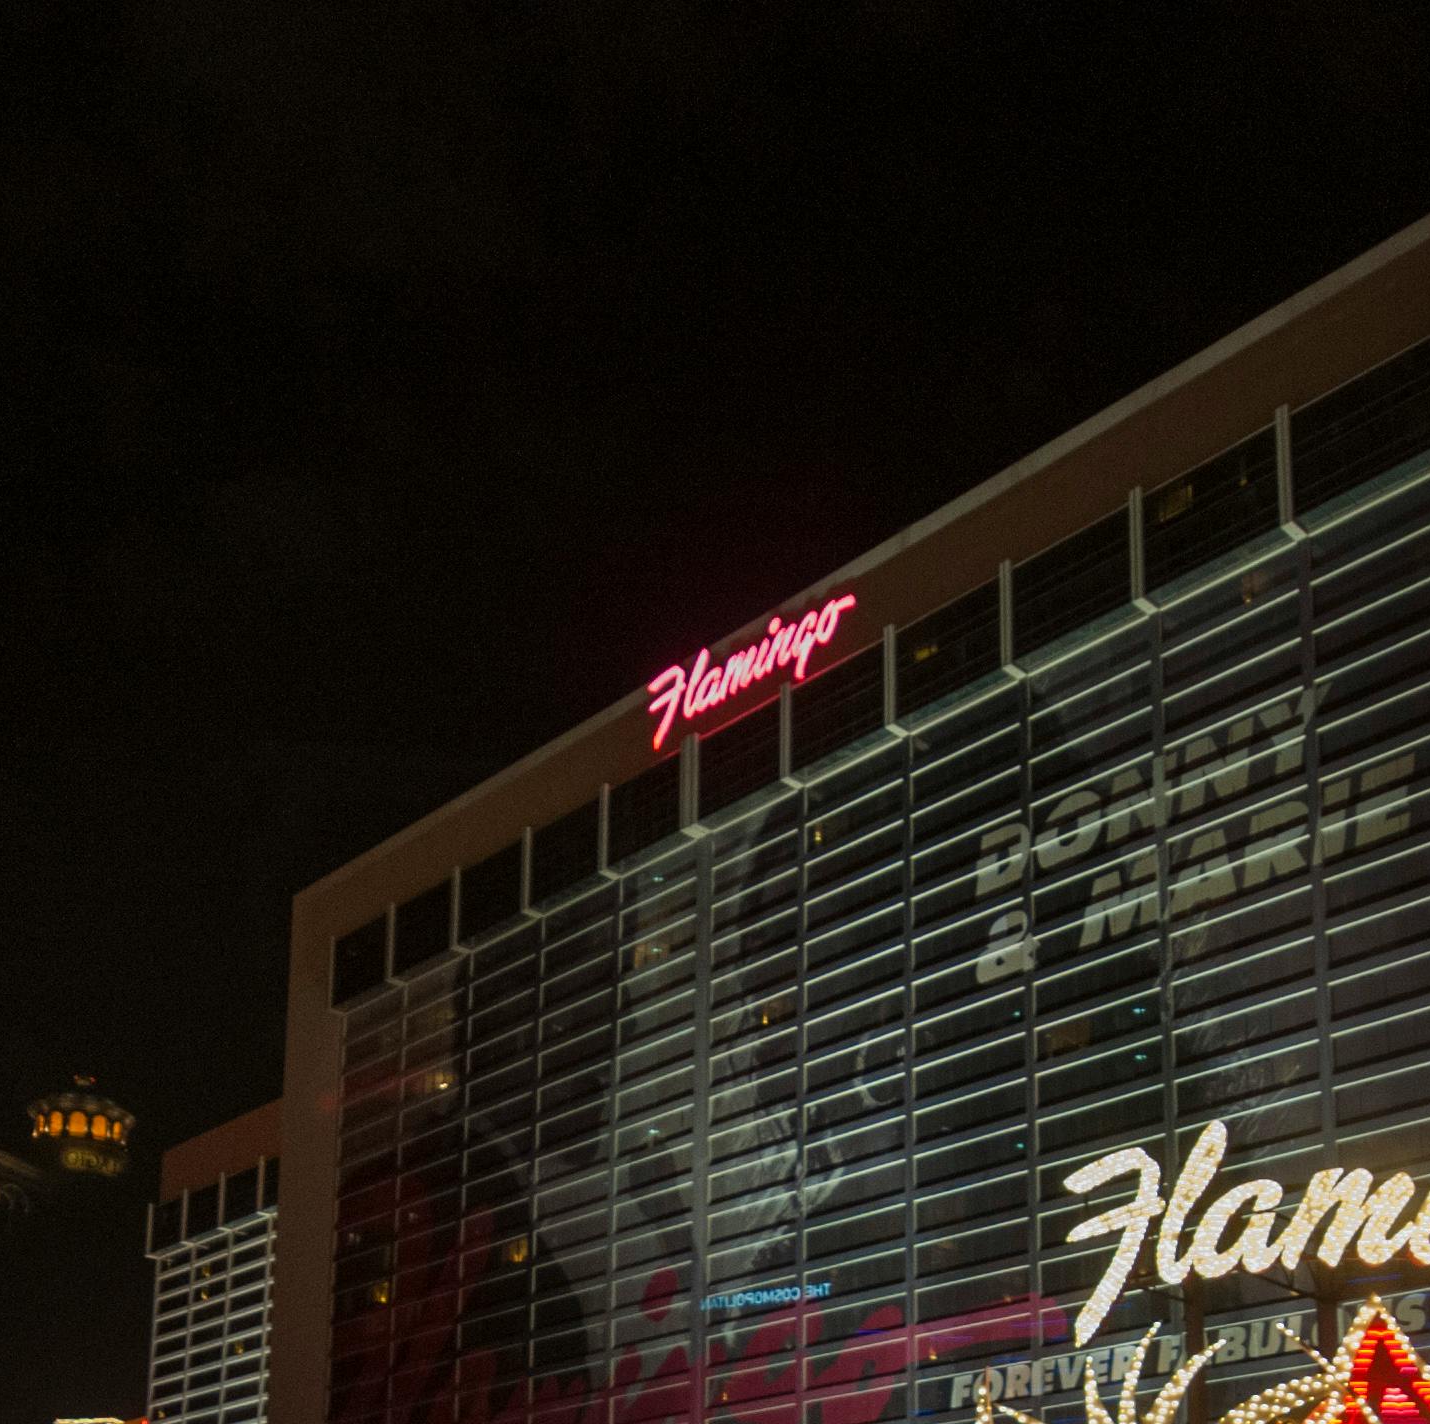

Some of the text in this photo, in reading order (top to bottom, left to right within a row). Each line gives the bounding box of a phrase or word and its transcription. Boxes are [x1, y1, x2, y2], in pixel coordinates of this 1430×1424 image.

[648, 593, 857, 751] Flamingo
[975, 682, 1333, 899] DONNY
[1078, 752, 1417, 950] MARIE
[951, 1346, 1134, 1409] FOREVER
